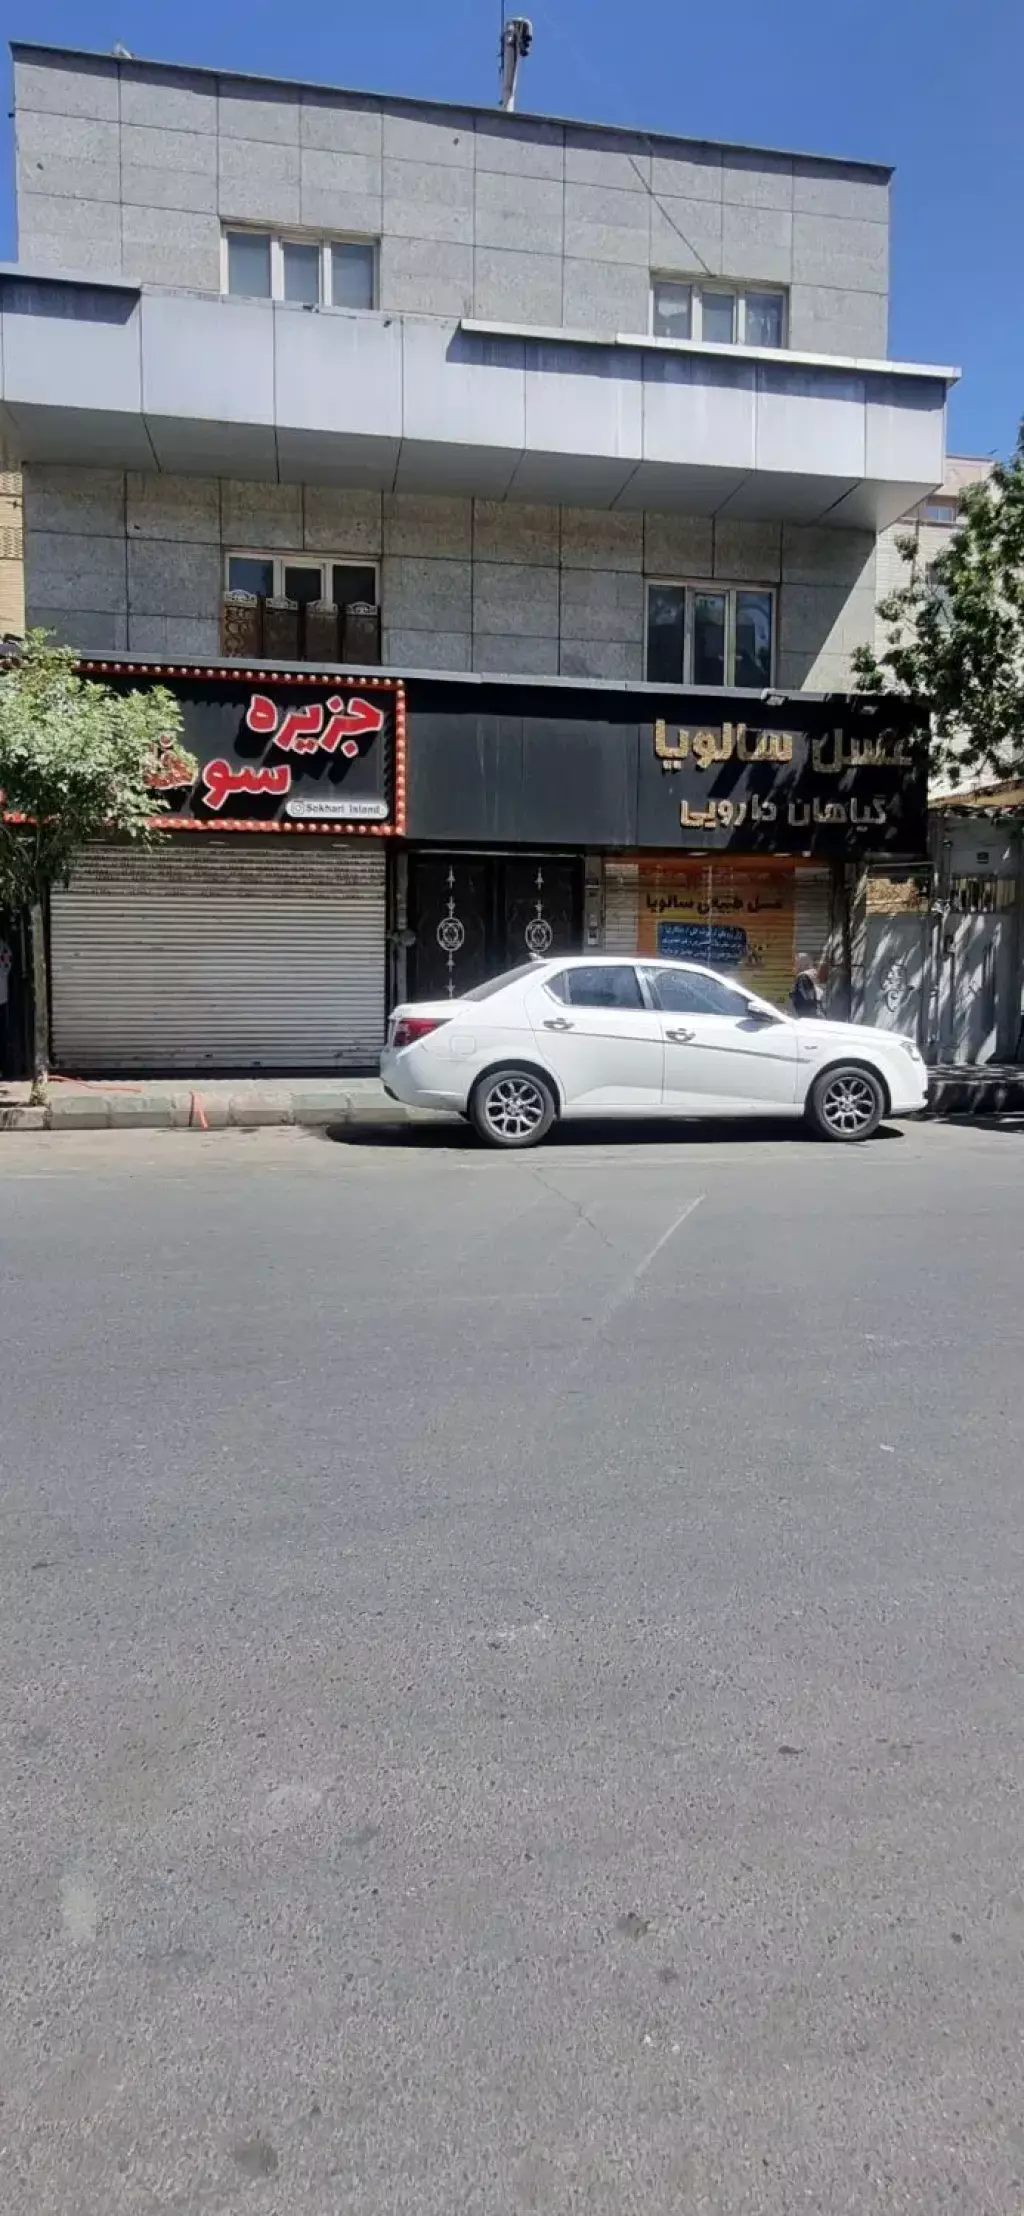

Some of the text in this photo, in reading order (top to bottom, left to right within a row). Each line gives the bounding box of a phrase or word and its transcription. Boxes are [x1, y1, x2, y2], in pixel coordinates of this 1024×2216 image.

[246, 694, 384, 758] جزیره
[654, 718, 912, 773] عسل سالویا
[679, 793, 888, 833] گیاهان دارویی
